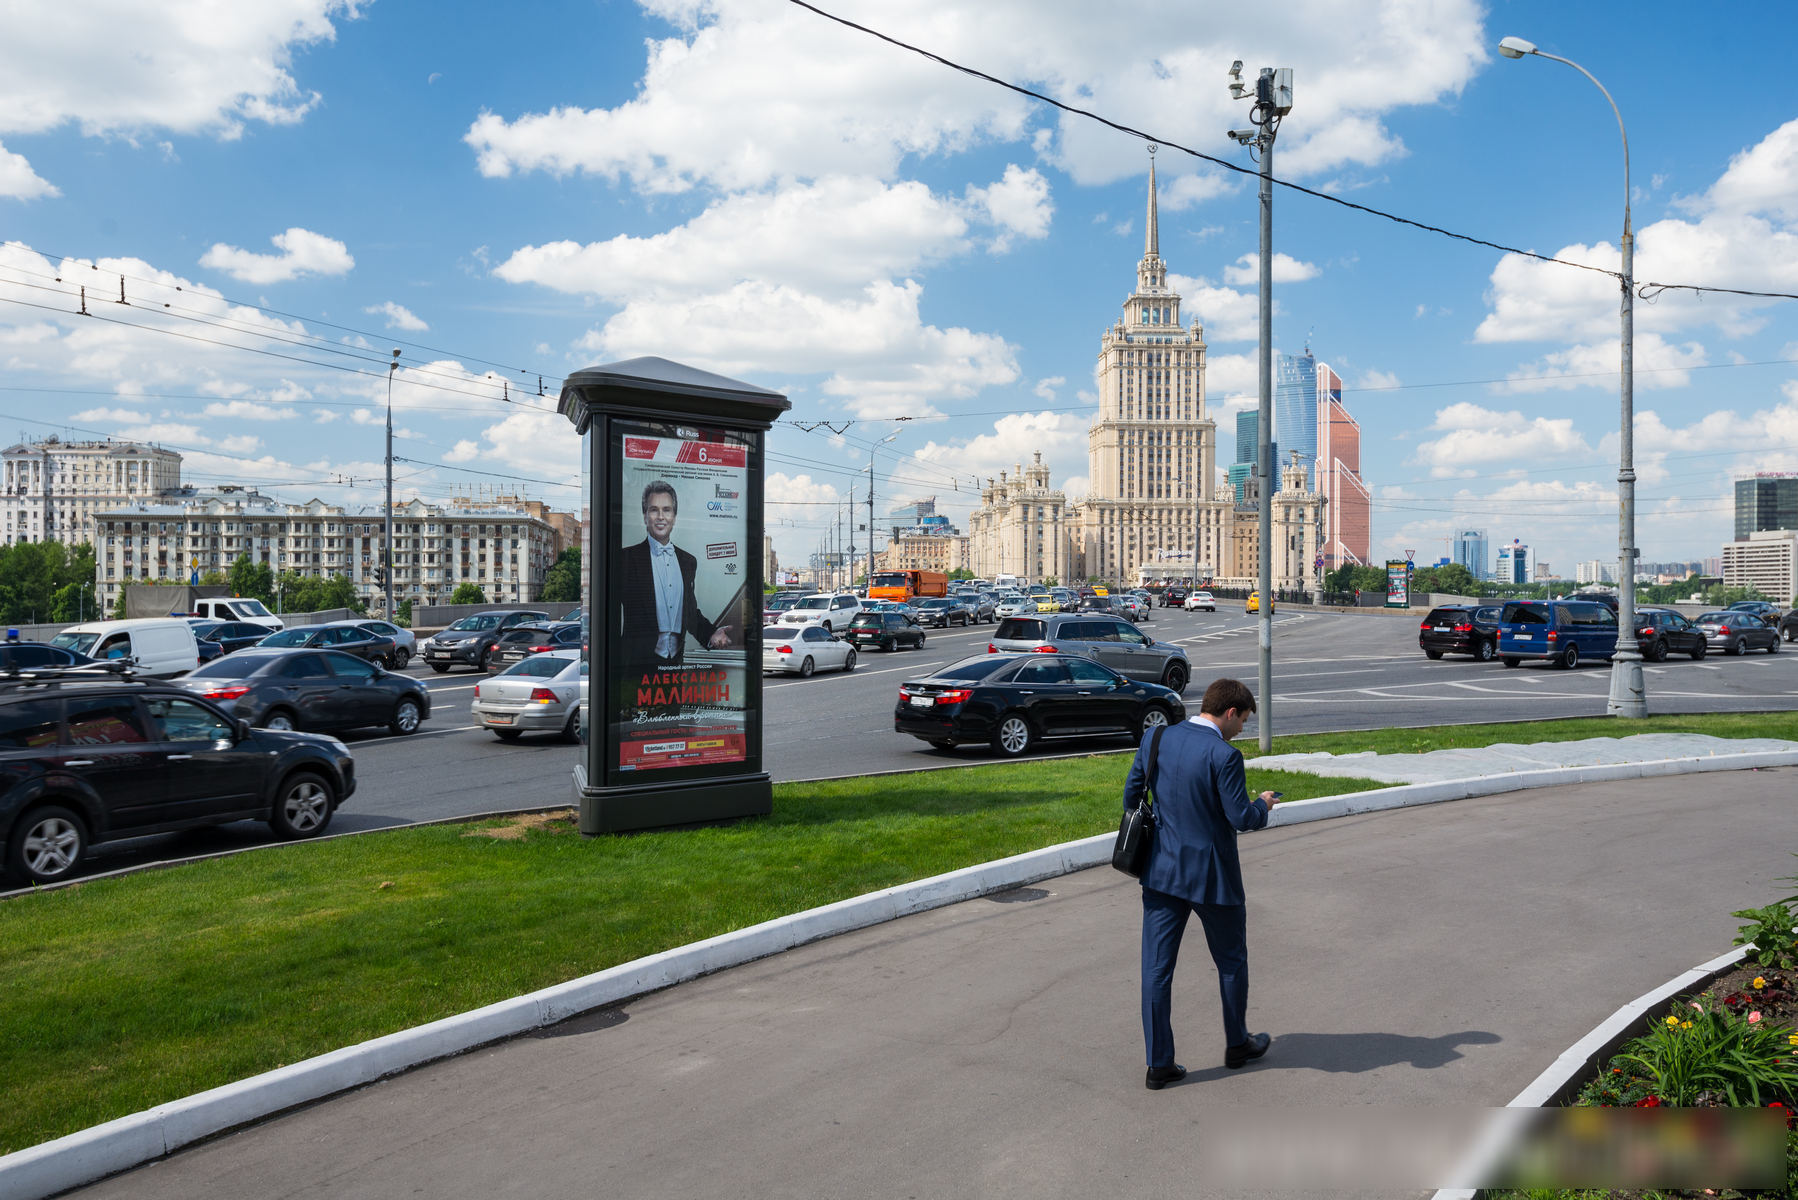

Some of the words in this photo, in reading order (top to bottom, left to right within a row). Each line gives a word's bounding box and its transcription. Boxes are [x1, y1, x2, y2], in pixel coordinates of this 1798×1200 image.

[686, 430, 699, 438] Russ
[699, 447, 707, 462] 6
[641, 671, 728, 685] АЛЕКСАНДР
[637, 684, 730, 706] МАЛИНИН
